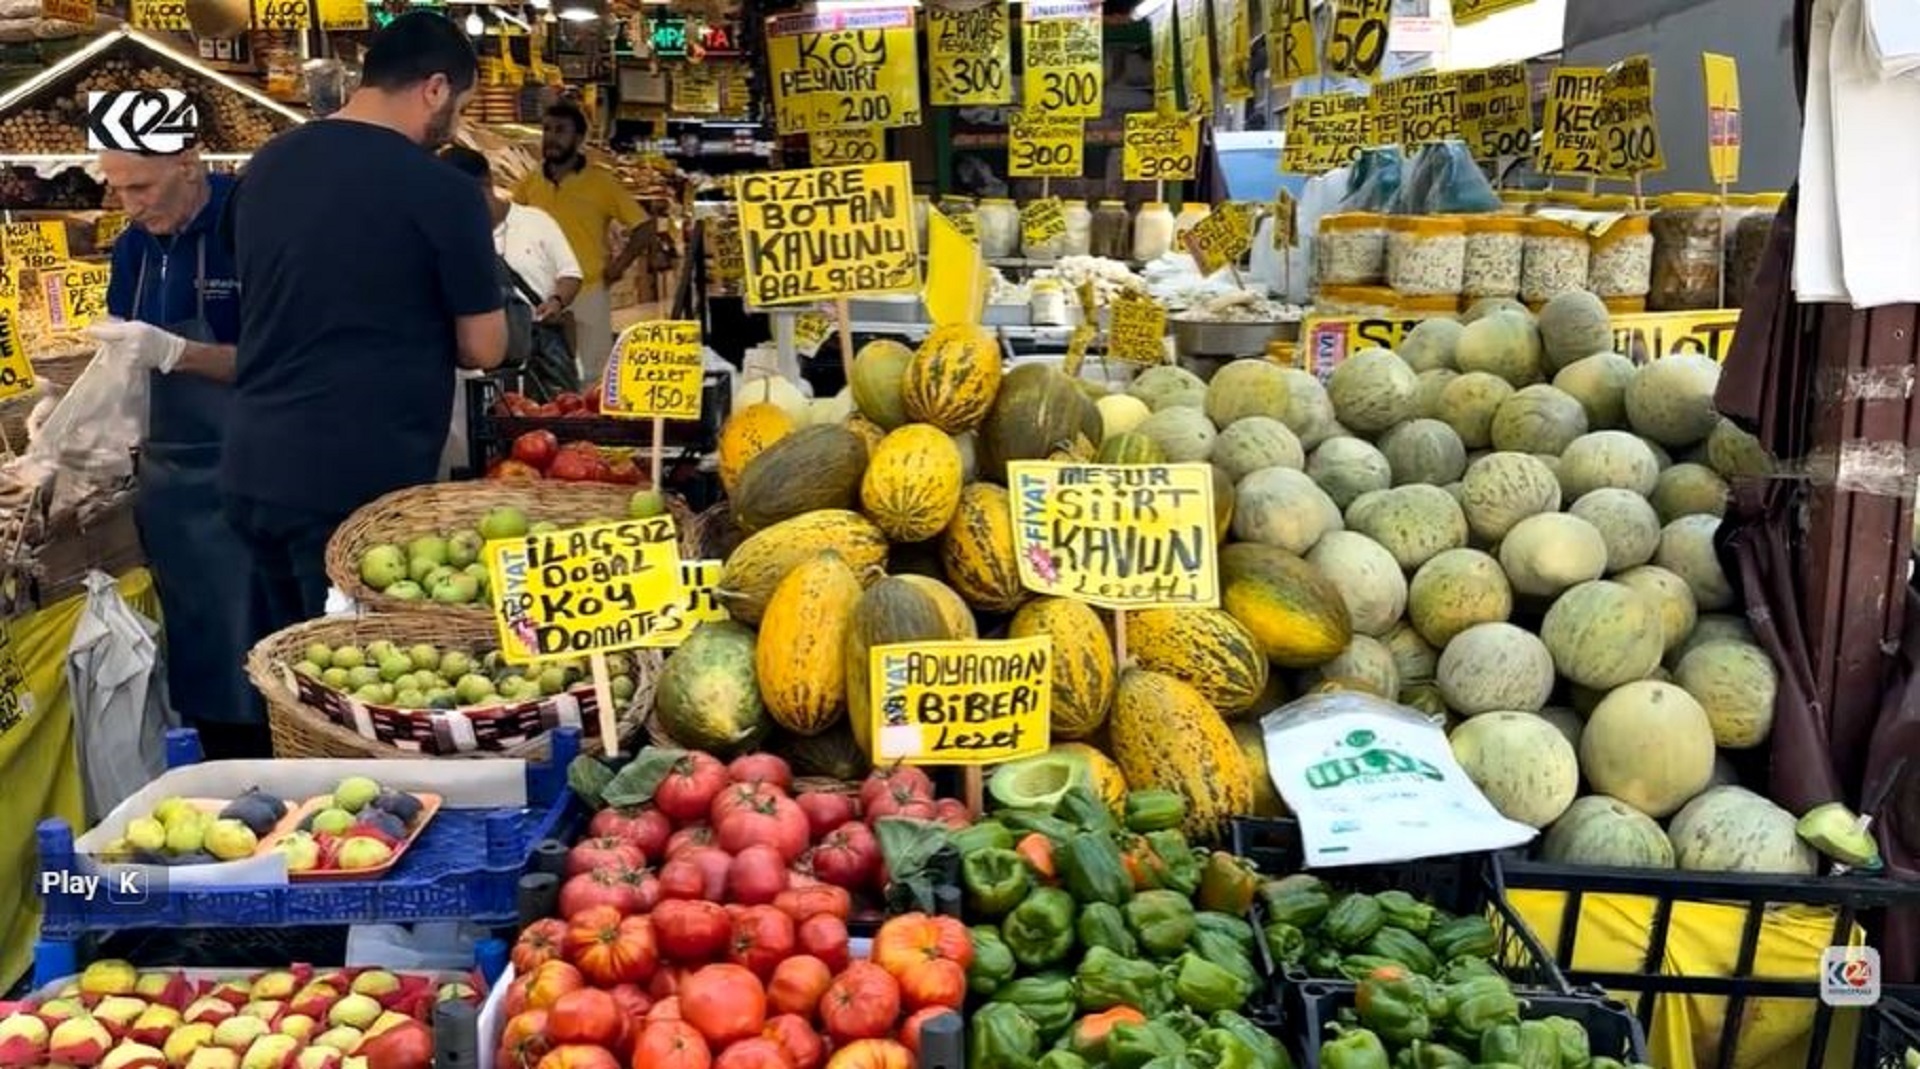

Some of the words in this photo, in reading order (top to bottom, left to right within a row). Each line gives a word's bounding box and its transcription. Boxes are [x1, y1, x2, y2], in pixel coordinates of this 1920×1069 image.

[798, 28, 887, 70] KÖY
[780, 66, 885, 98] PEYNİRİ
[952, 58, 1004, 95] 300
[1041, 71, 1097, 111] 300
[1555, 75, 1606, 100] MAR
[841, 95, 892, 124] 200
[821, 139, 878, 160] 200
[1015, 141, 1073, 169] 300
[1481, 129, 1531, 158] 500
[1555, 134, 1596, 149] PEYN
[1608, 126, 1655, 170] 300
[1139, 155, 1193, 178] 300
[761, 185, 896, 230] BOTAN
[20, 255, 57, 268] 180
[750, 225, 906, 276] KAVUNU
[759, 272, 820, 302] BAL
[645, 385, 683, 411] 150
[1058, 467, 1171, 490] MEŞUR
[1056, 488, 1200, 523] SİİRT
[1052, 519, 1203, 579] KAVUN
[541, 583, 637, 622] KÖY
[536, 603, 683, 655] DOMATES
[907, 648, 1046, 687] ADIYAMAN
[918, 679, 1043, 725] BİBERİ
